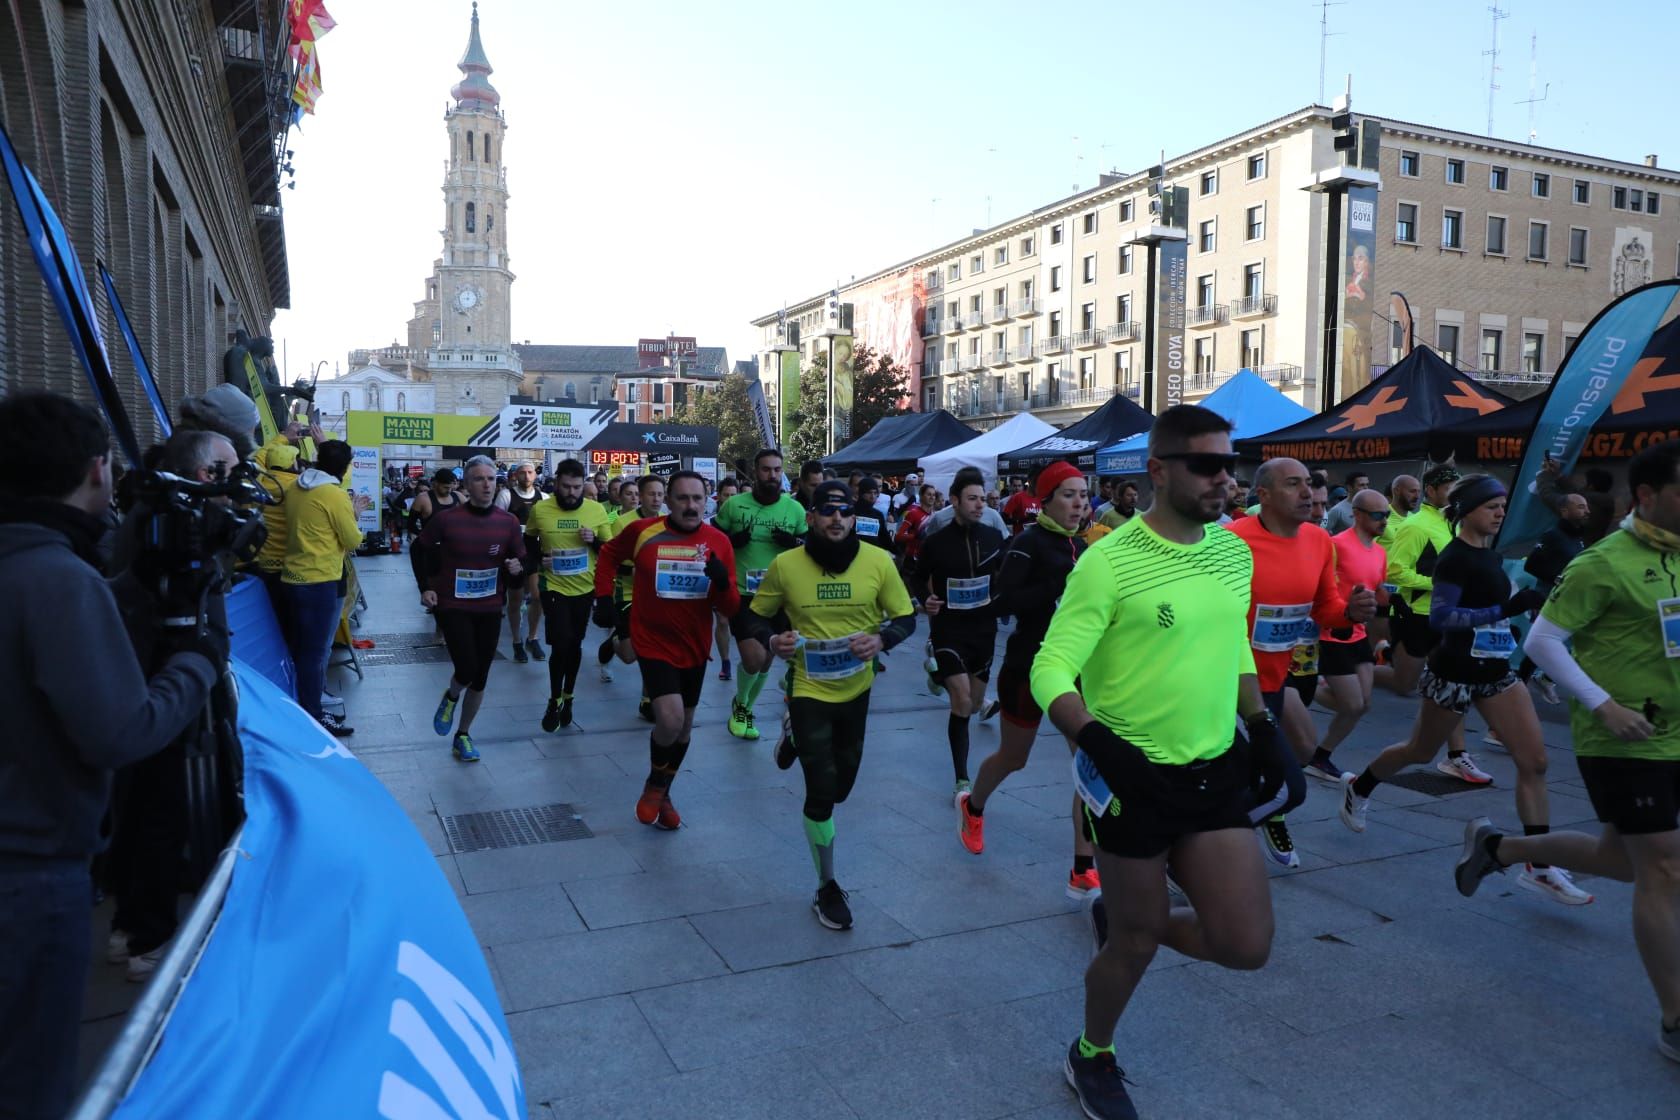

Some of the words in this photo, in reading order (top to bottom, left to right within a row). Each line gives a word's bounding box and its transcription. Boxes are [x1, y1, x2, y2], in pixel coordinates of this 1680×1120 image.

[1353, 211, 1371, 222] GOYA
[641, 343, 664, 352] TIBUR
[667, 341, 695, 350] HOTEL
[1168, 335, 1182, 369] GOYA
[1168, 373, 1181, 407] USEO
[1545, 336, 1626, 468] uironsalud
[387, 419, 431, 428] MANN
[387, 428, 431, 438] FILTER
[659, 433, 699, 443] CaixaBank
[1261, 437, 1390, 460] RUNNINGZGZ.COM
[561, 559, 581, 567] 3215
[669, 575, 700, 586] 3227
[819, 584, 849, 592] MANN
[821, 655, 852, 666] 3314
